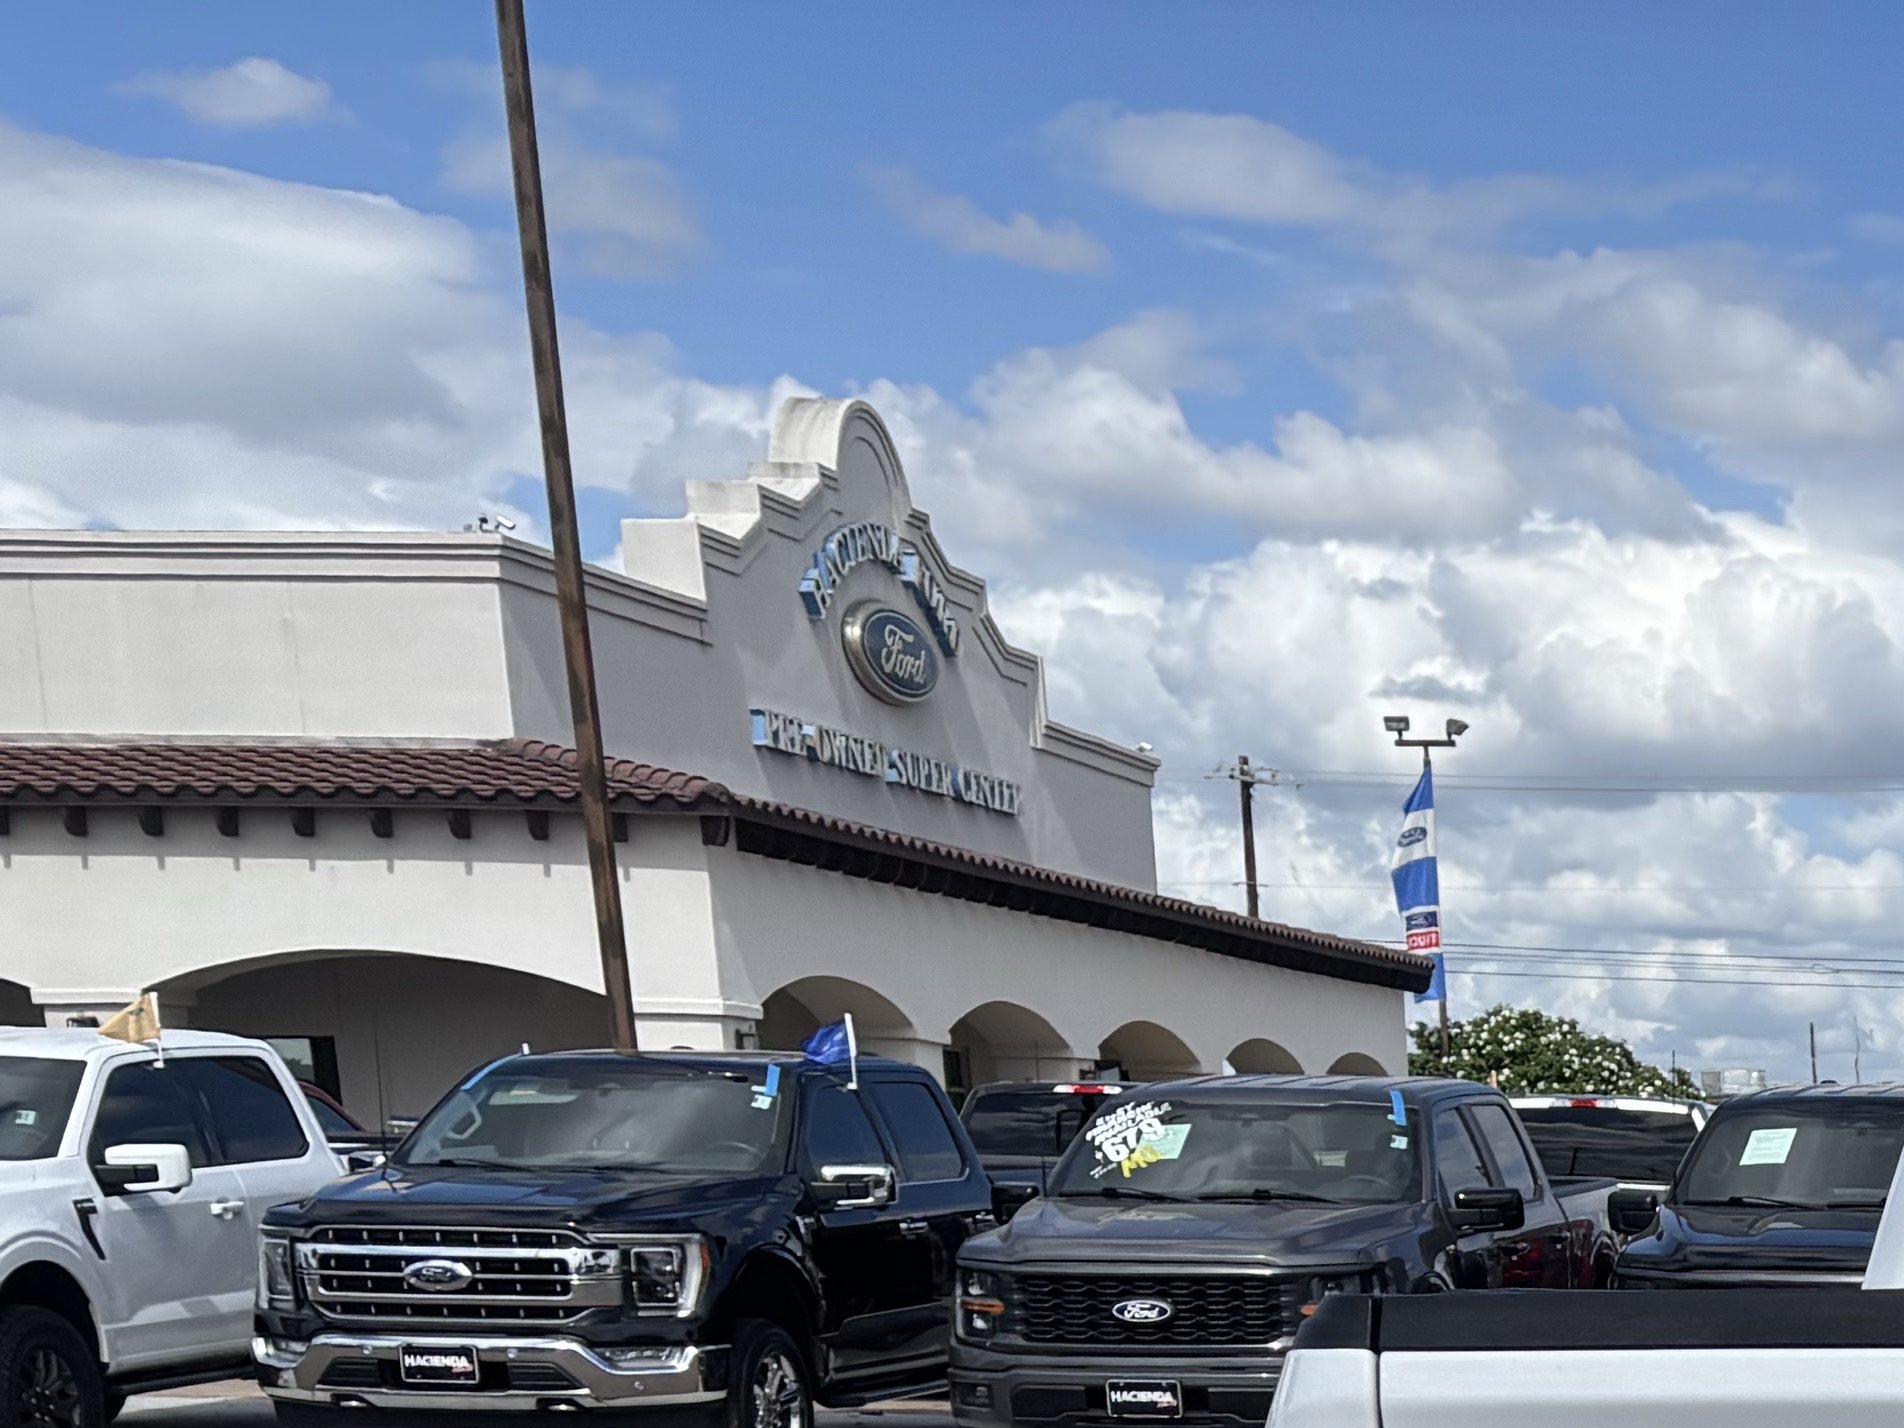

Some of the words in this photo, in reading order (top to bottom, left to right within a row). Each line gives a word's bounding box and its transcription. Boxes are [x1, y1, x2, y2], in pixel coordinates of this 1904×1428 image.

[880, 624, 926, 685] Ford
[886, 750, 958, 798] SUPER
[953, 765, 1022, 816] CENTER
[1123, 1301, 1160, 1319] Ford
[403, 1354, 469, 1368] HACIENDA
[1110, 1390, 1176, 1403] HACIENDA
